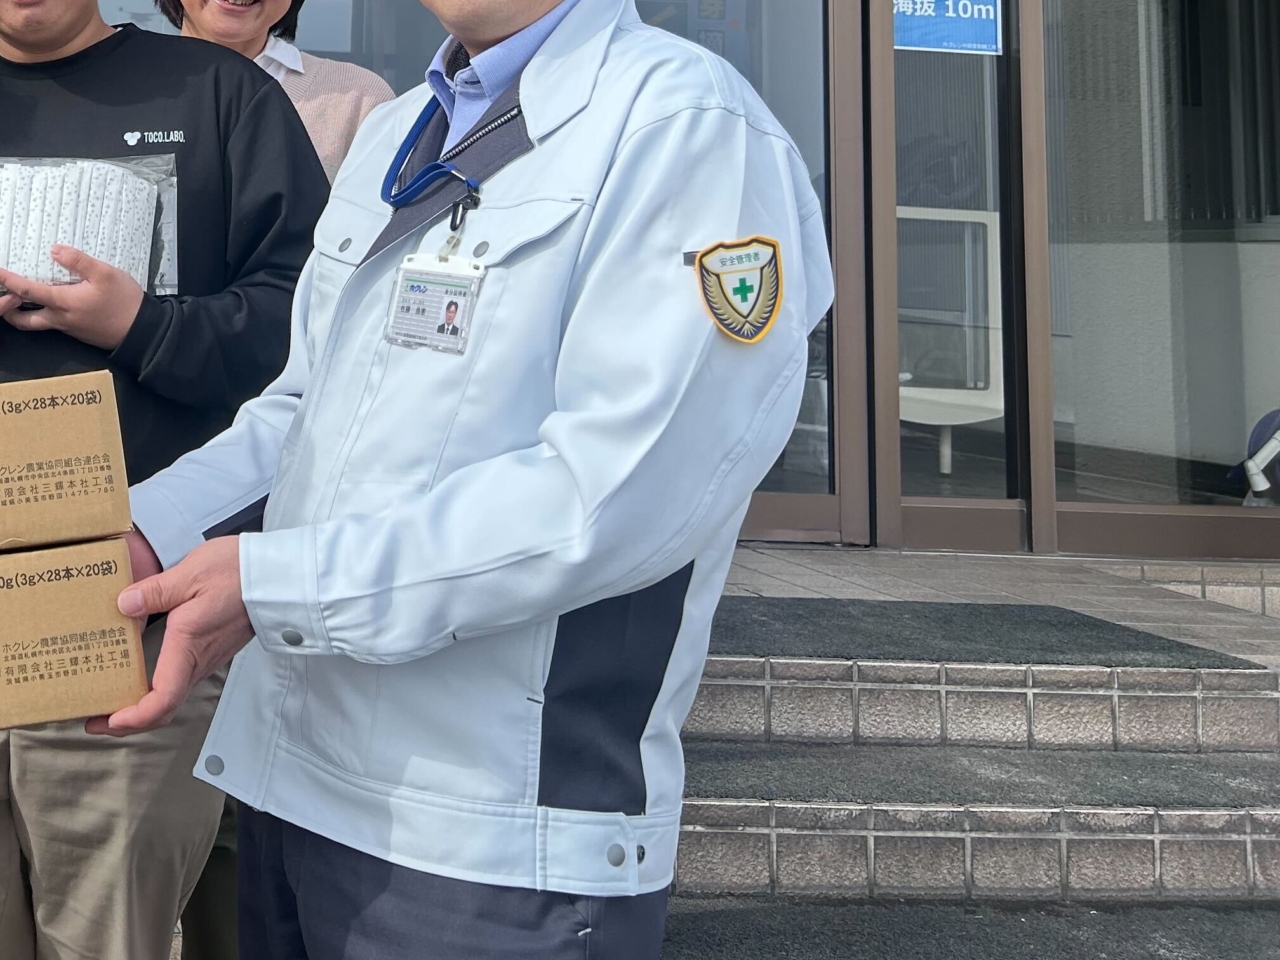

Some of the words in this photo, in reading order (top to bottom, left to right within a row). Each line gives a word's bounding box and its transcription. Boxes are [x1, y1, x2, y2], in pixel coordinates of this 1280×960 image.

[143, 130, 186, 143] TOCO.LABO.
[719, 251, 760, 268] 安全管理者
[409, 285, 428, 294] ホクレン
[2, 626, 127, 654] ホクレン農業協同組合連合会
